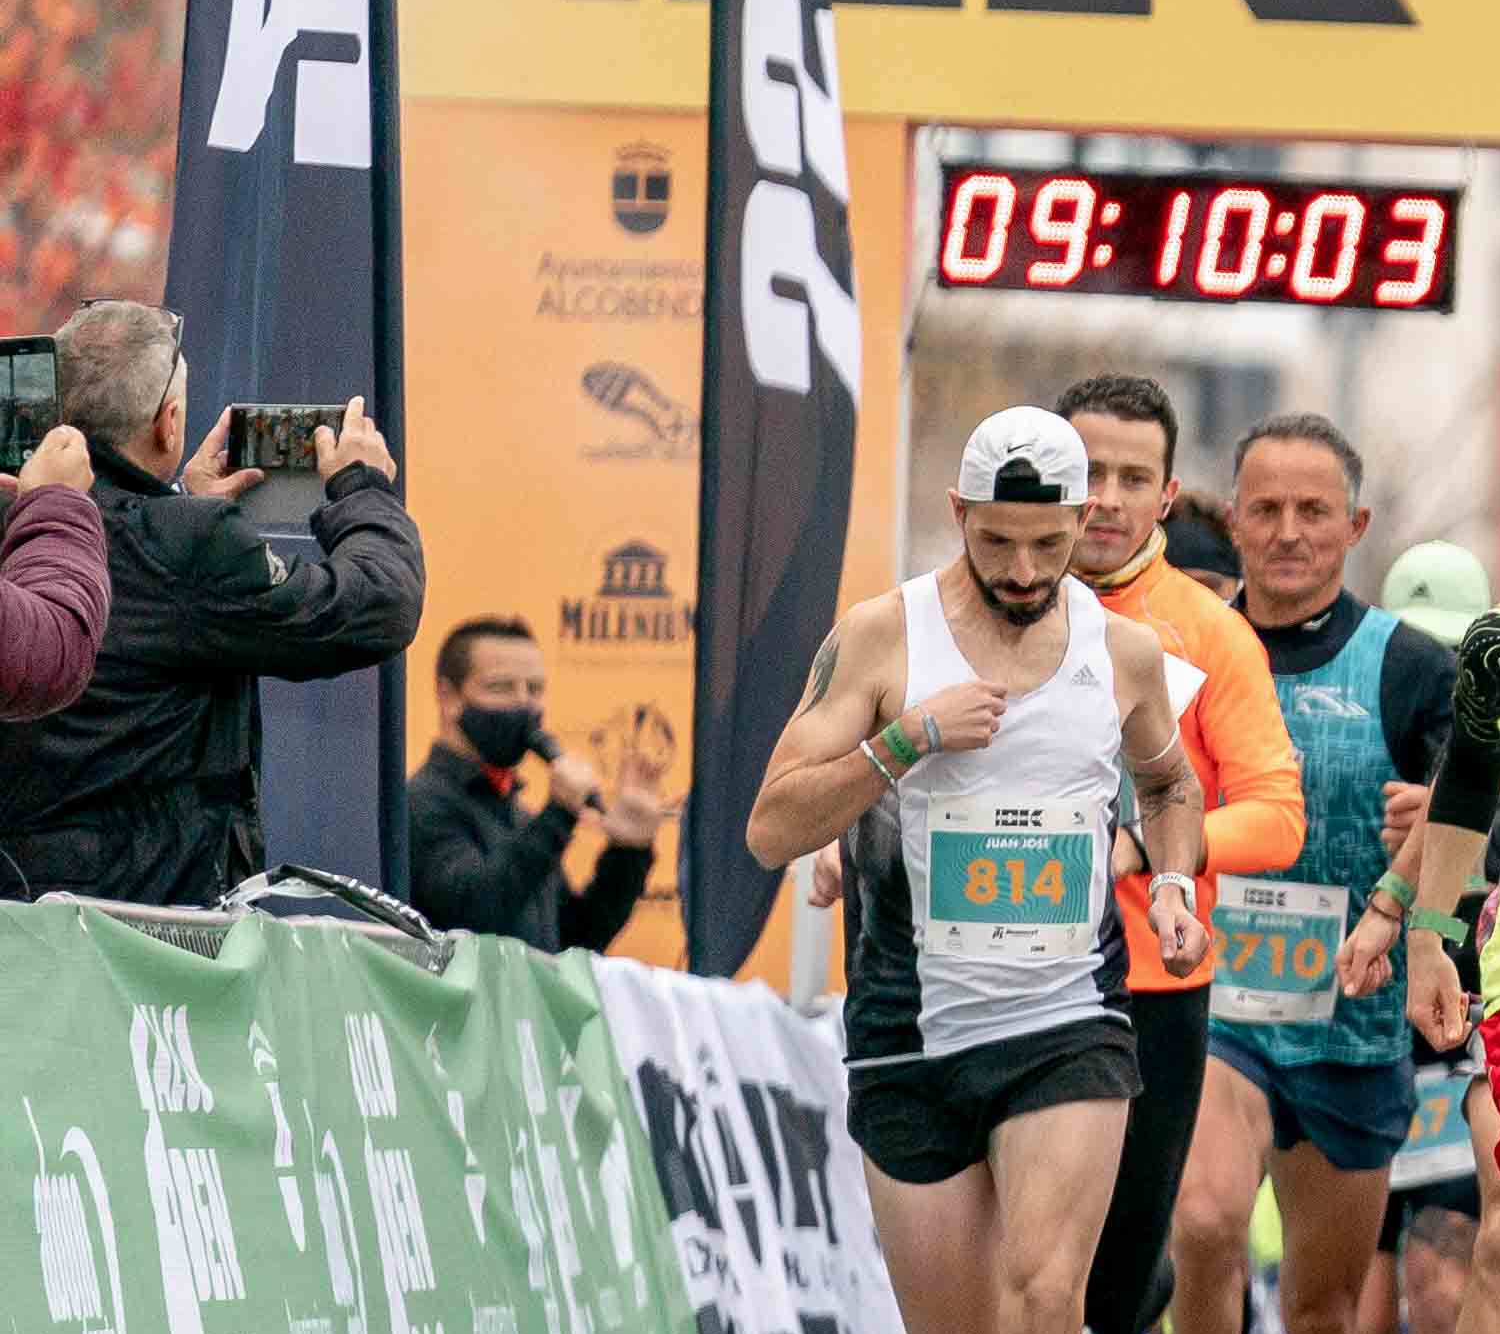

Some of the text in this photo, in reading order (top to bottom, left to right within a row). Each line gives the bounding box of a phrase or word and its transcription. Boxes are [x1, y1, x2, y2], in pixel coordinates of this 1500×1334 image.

[943, 172, 1446, 306] 09:10:03
[536, 287, 703, 319] ALCOBEND
[994, 808, 1044, 828] 10K
[964, 858, 1067, 906] 814
